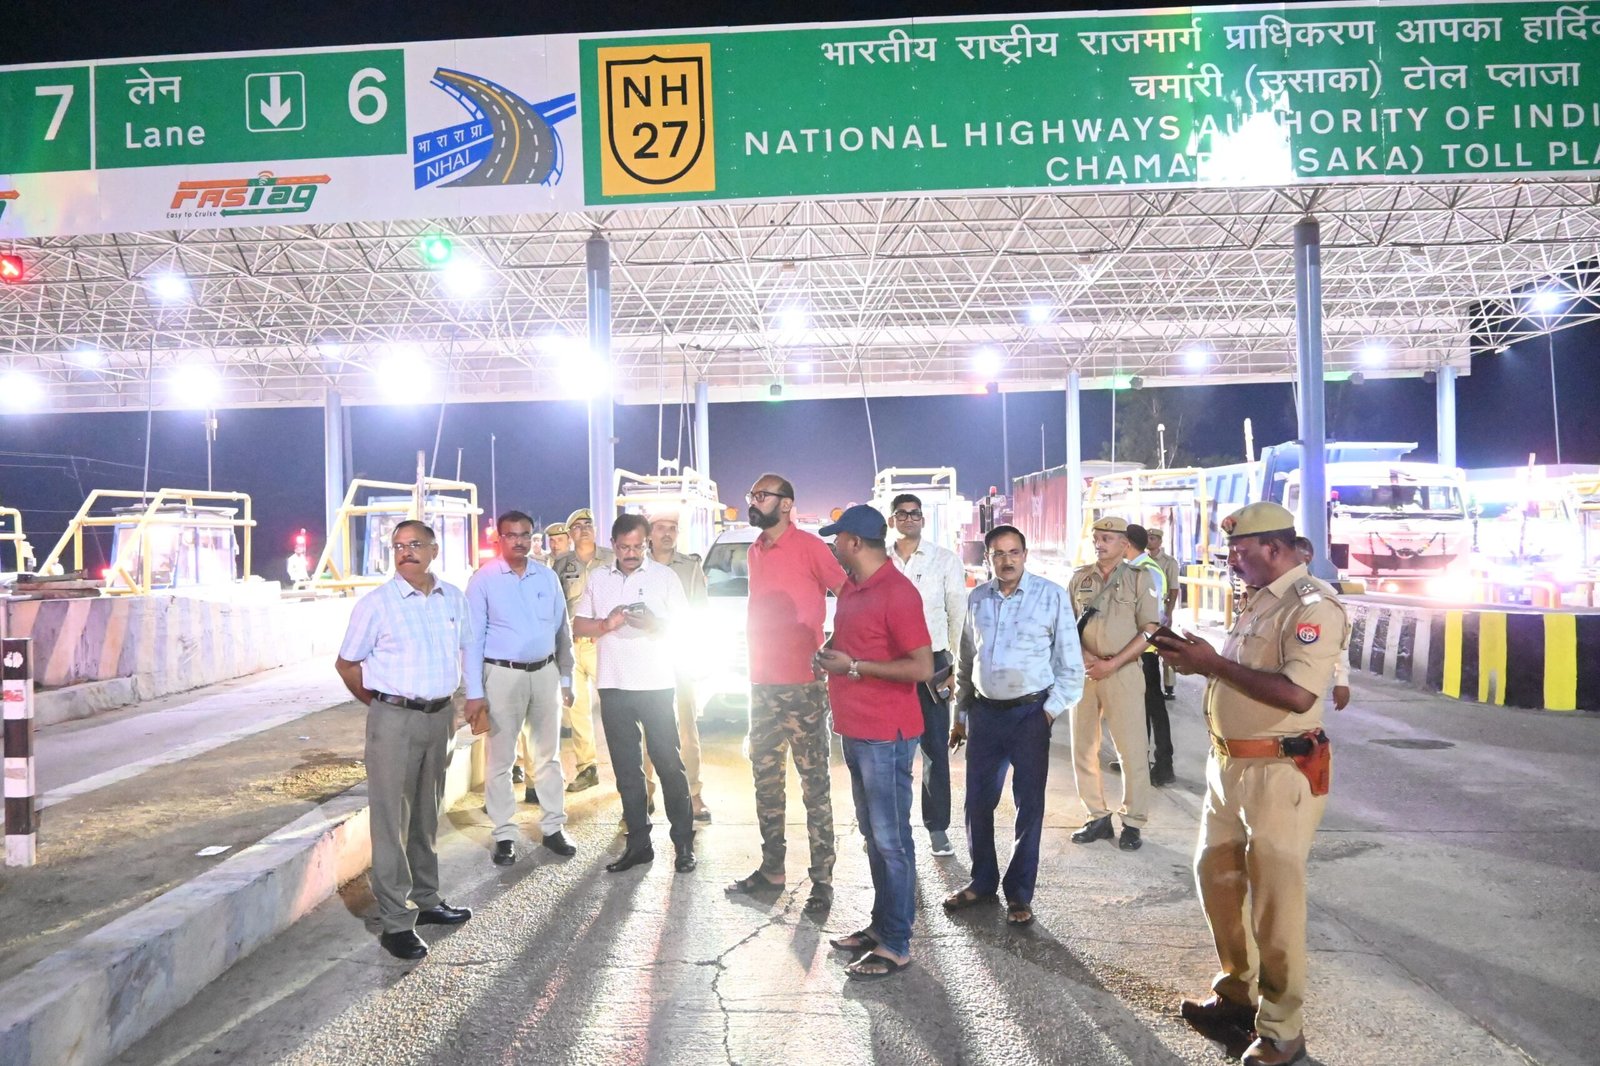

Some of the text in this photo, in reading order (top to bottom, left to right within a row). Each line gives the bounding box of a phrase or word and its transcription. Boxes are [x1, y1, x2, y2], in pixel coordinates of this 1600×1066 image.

[821, 28, 937, 66] भारतीय
[956, 23, 1059, 65] राष्ट्रीय
[1079, 17, 1202, 55] राजमार्ग
[1223, 14, 1376, 50] प्राधिकरण
[1396, 17, 1502, 44] आपका
[126, 67, 182, 105] लेन
[622, 73, 689, 109] NH
[1402, 56, 1468, 90] टोल
[1485, 62, 1581, 88] प्लाजा
[35, 84, 75, 141] 7
[348, 67, 388, 125] 6
[126, 122, 206, 149] Lane
[436, 134, 449, 148] रा
[453, 129, 466, 143] रा
[632, 119, 689, 160] 27
[745, 124, 948, 156] NATIONAL
[964, 114, 1181, 147] HIGHWAYS
[1199, 107, 1429, 140] AUHORITY
[1445, 104, 1496, 131] OF
[426, 148, 471, 182] NHAI
[1441, 142, 1533, 168] TOLL
[166, 210, 217, 219] Easy to Cruise
